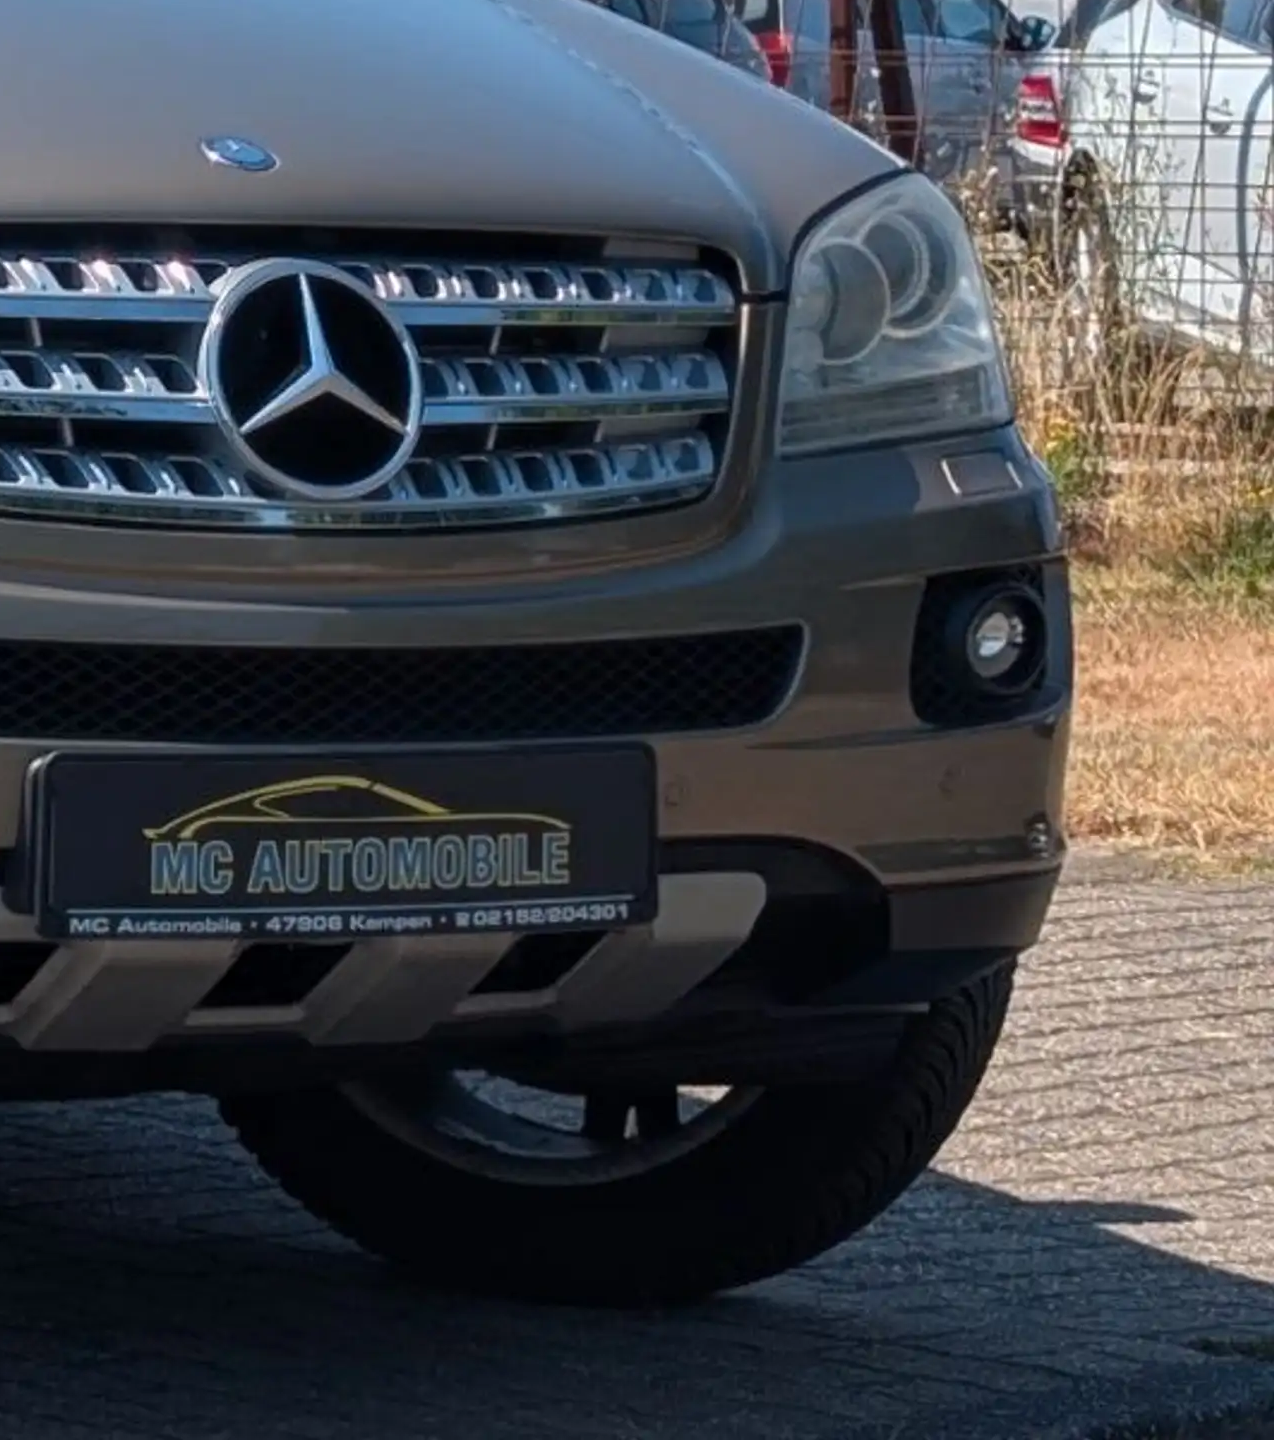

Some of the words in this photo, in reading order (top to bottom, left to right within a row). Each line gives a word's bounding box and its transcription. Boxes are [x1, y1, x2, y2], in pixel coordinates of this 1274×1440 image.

[150, 841, 234, 894] MC
[247, 831, 571, 893] AUTOMOBILE
[69, 917, 110, 935] MC
[117, 917, 242, 935] Automobile
[350, 912, 432, 932] Kempen
